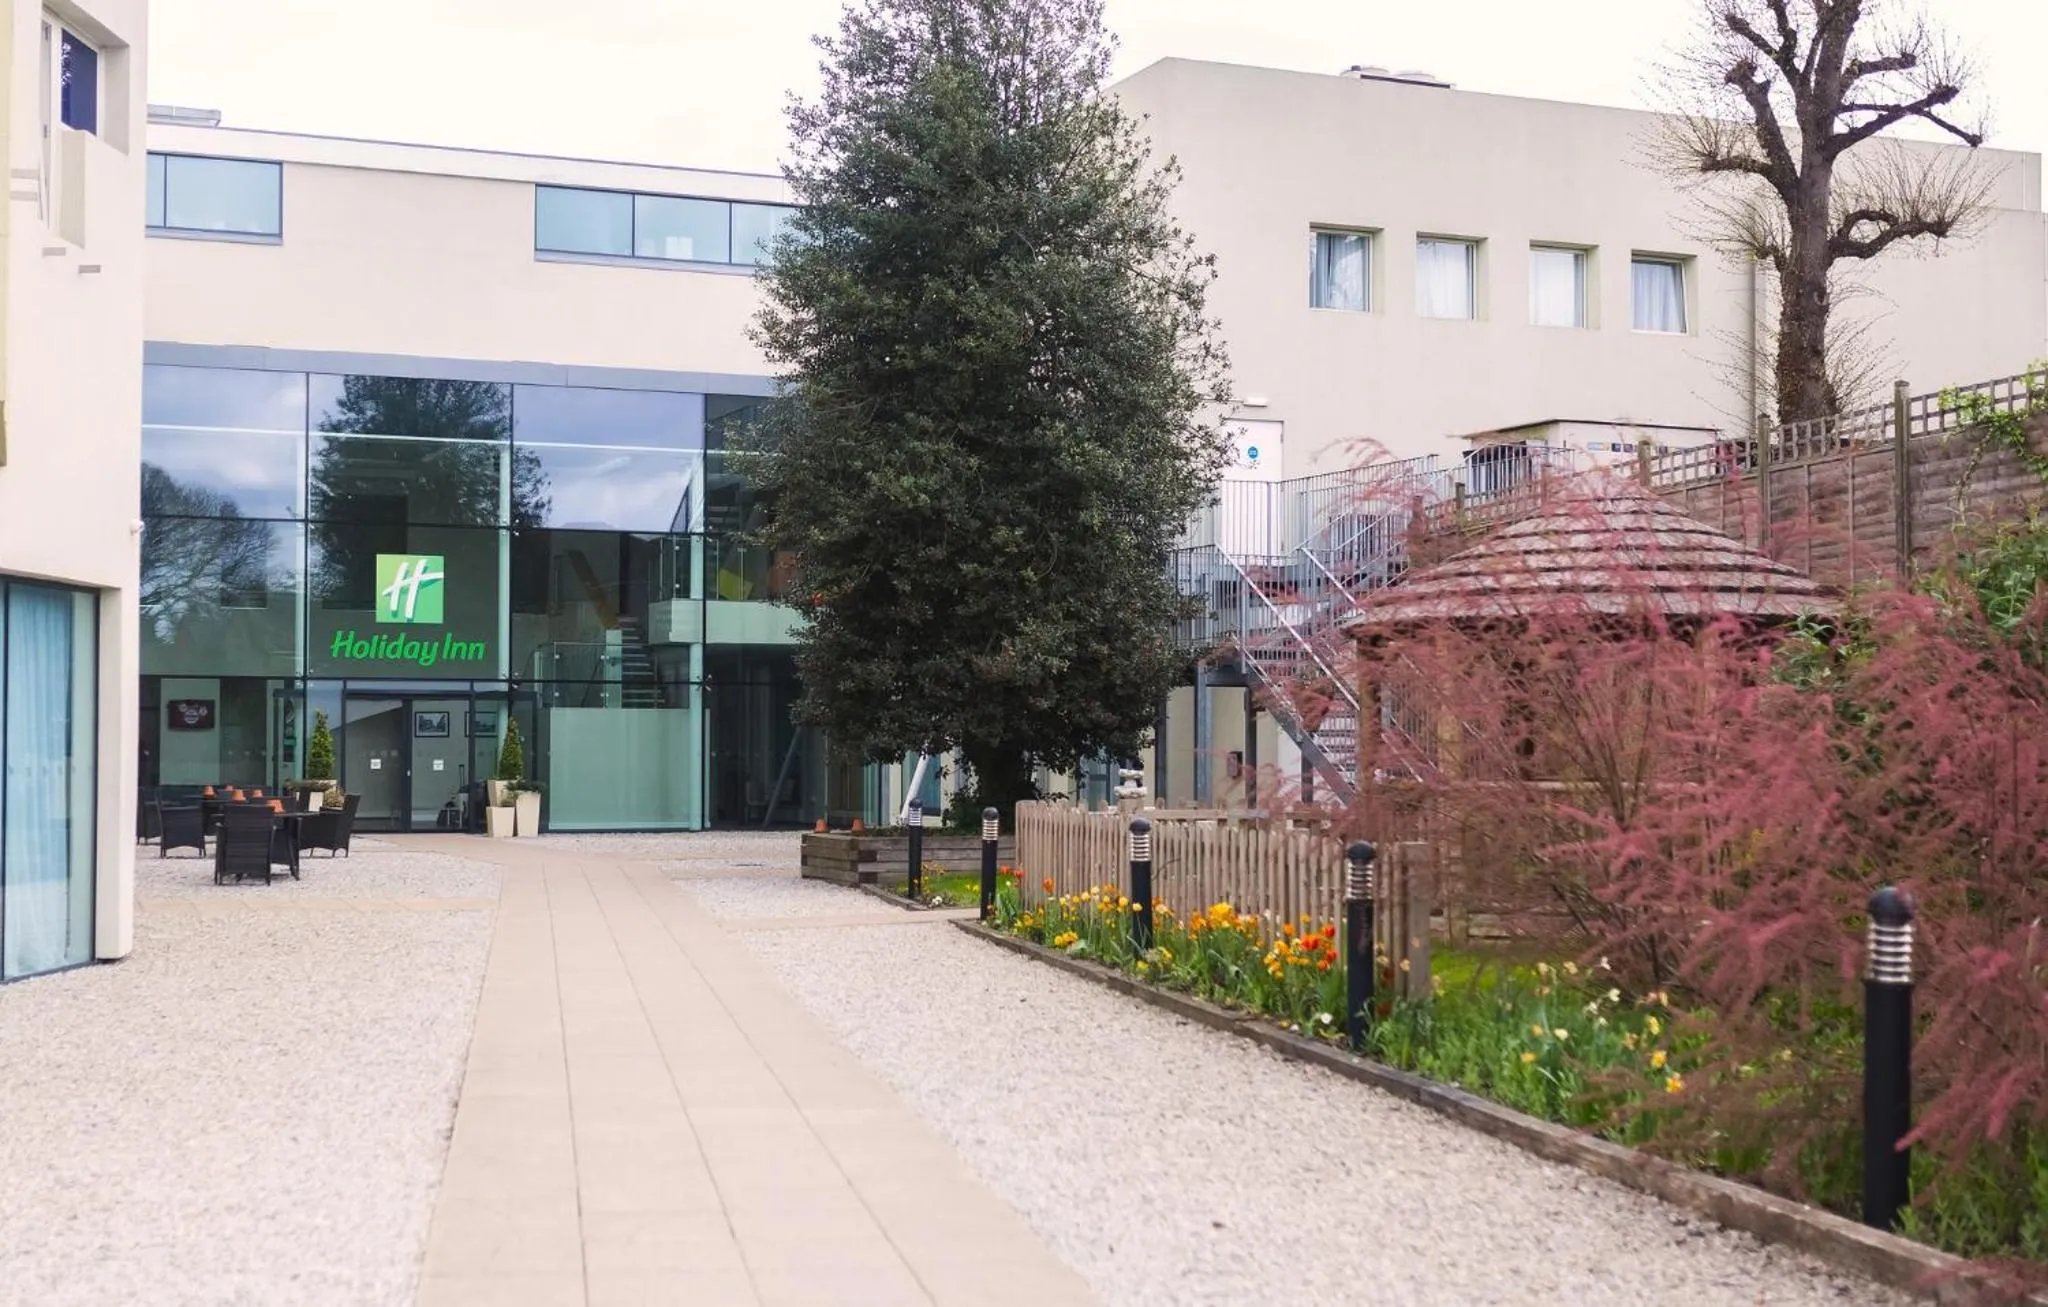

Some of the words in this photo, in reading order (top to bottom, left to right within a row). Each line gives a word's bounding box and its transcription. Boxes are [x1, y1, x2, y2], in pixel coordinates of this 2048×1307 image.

[382, 559, 444, 618] H
[331, 631, 439, 666] Holiday
[442, 632, 485, 660] Inn
